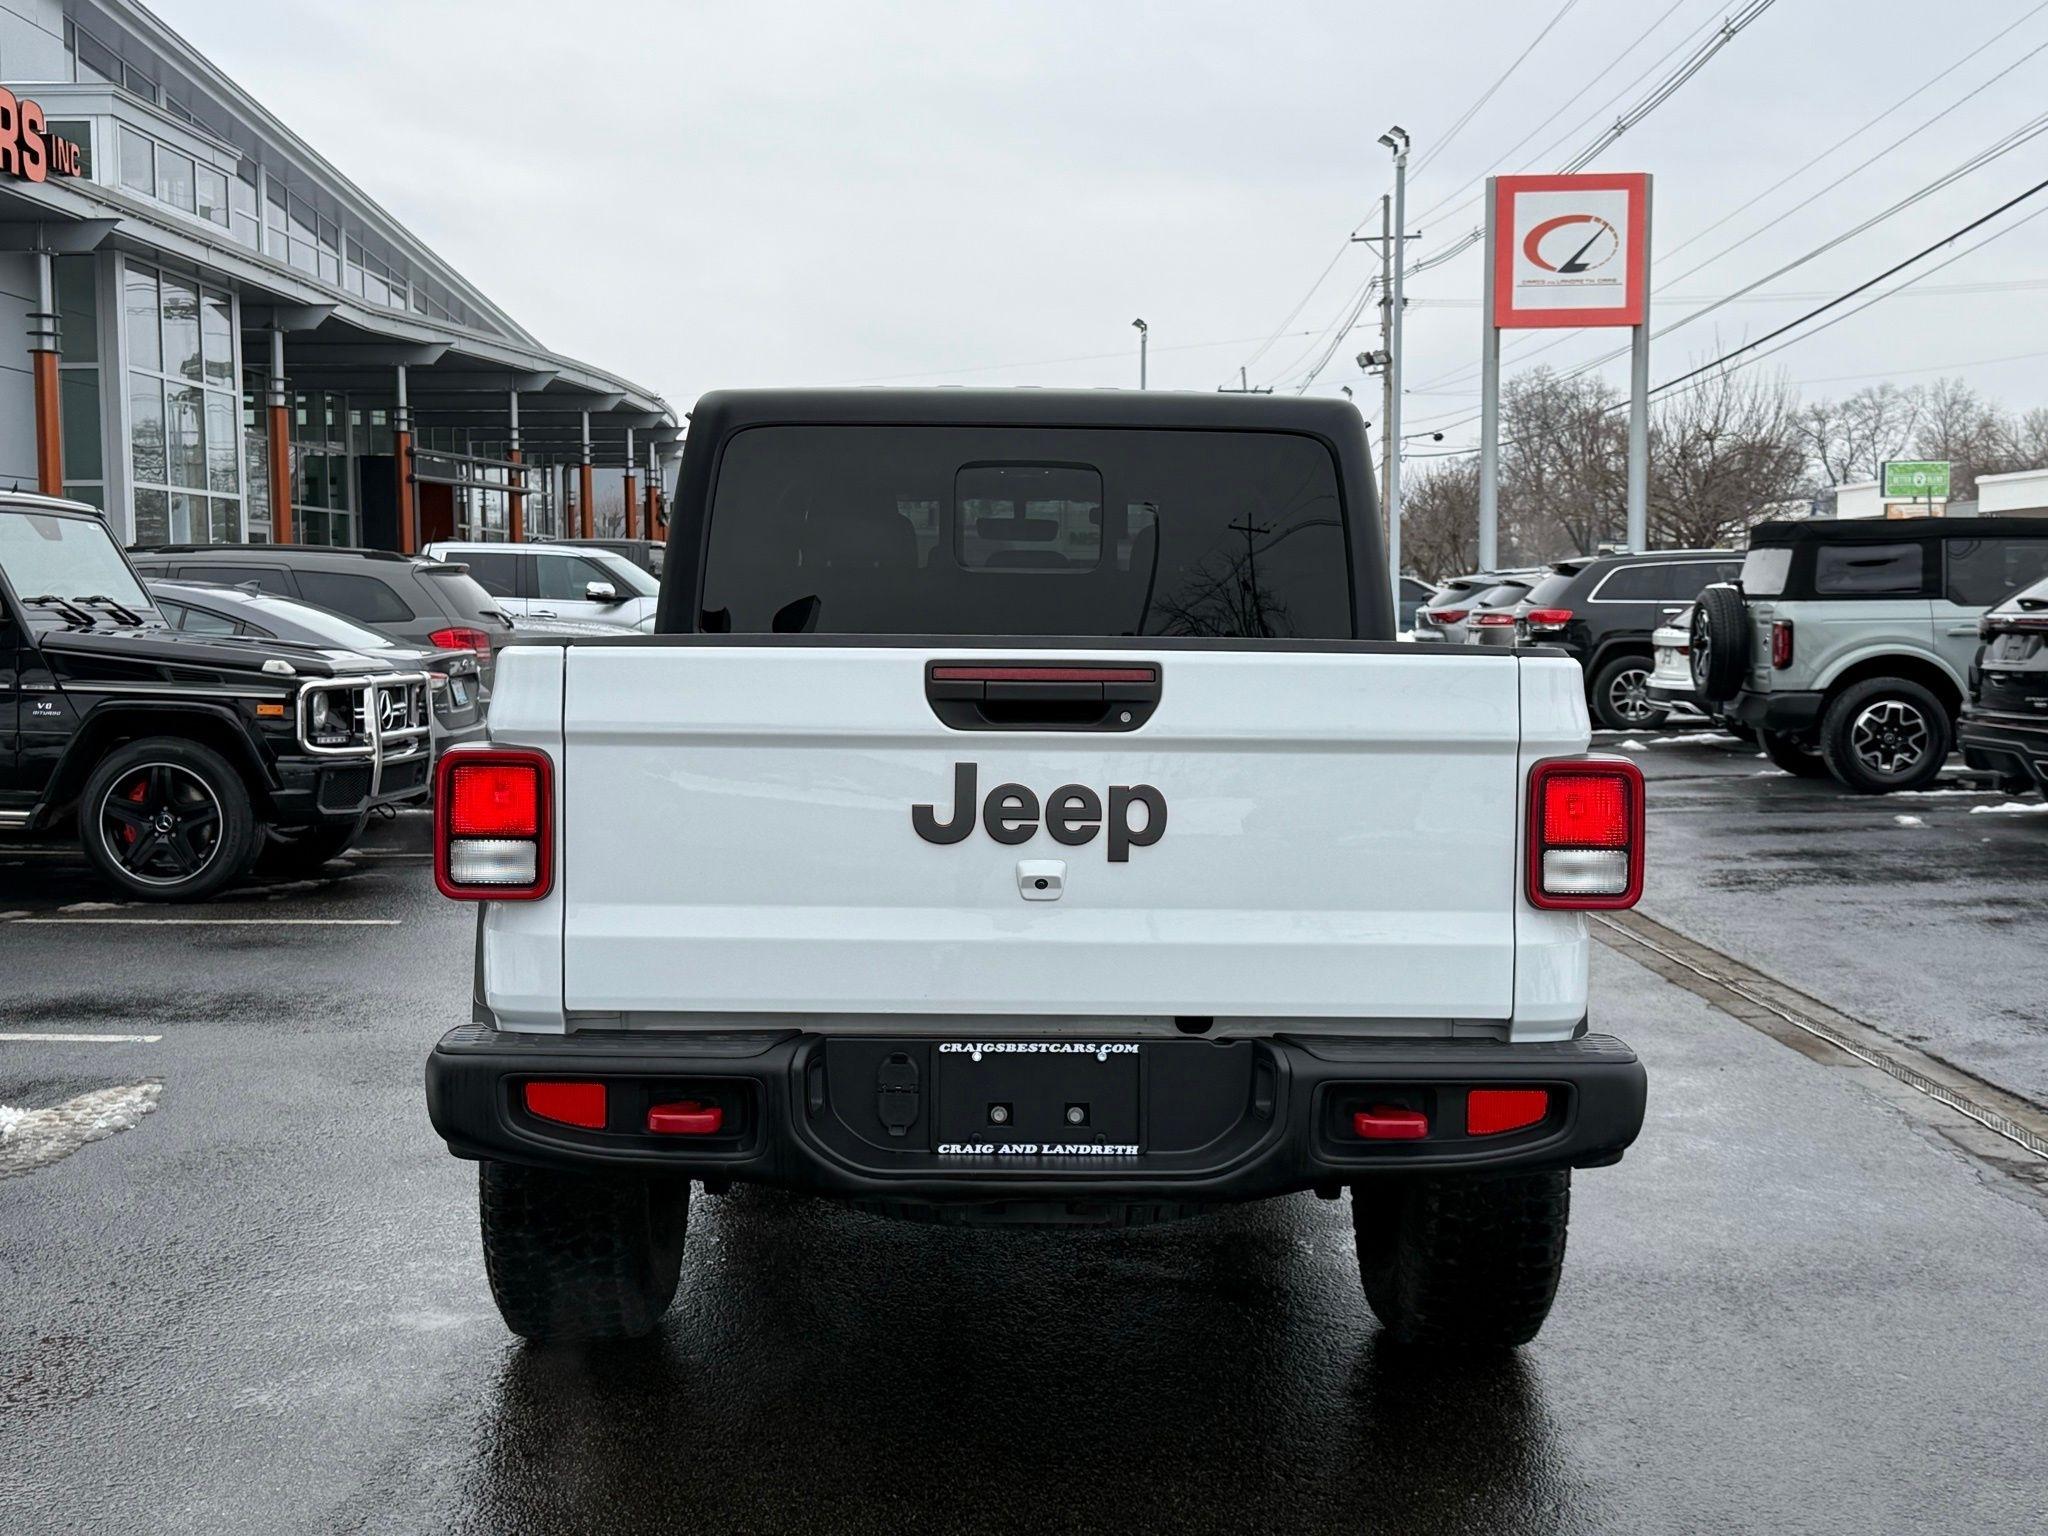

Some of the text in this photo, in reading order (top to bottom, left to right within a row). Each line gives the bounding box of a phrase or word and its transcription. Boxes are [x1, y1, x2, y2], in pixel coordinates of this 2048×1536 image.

[52, 134, 81, 178] INC
[911, 762, 1168, 863] Jeep
[939, 1043, 1139, 1053] CRAIGSBESTCARS.COM
[937, 1144, 1139, 1155] CRAIG AND LANDRETH
